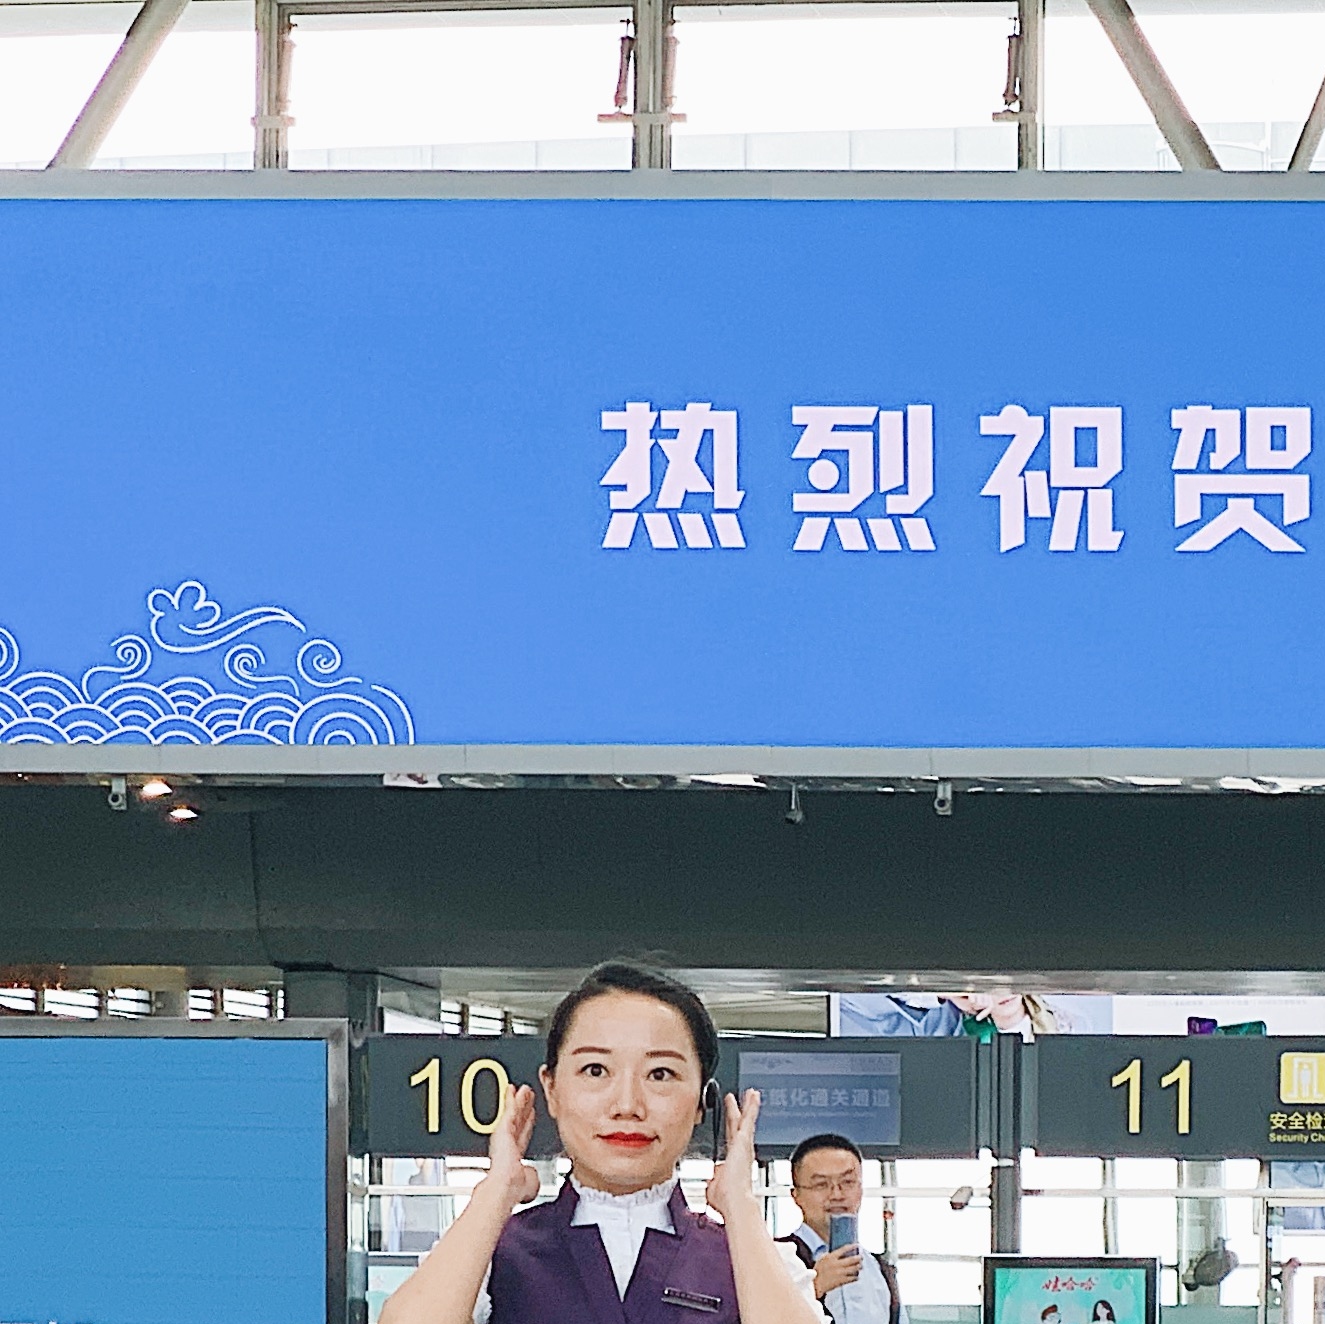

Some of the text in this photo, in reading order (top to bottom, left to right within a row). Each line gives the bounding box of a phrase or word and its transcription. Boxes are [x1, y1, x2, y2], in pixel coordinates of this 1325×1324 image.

[408, 1057, 510, 1135] 10
[1111, 1059, 1191, 1135] 11
[1269, 1132, 1309, 1144] Security
